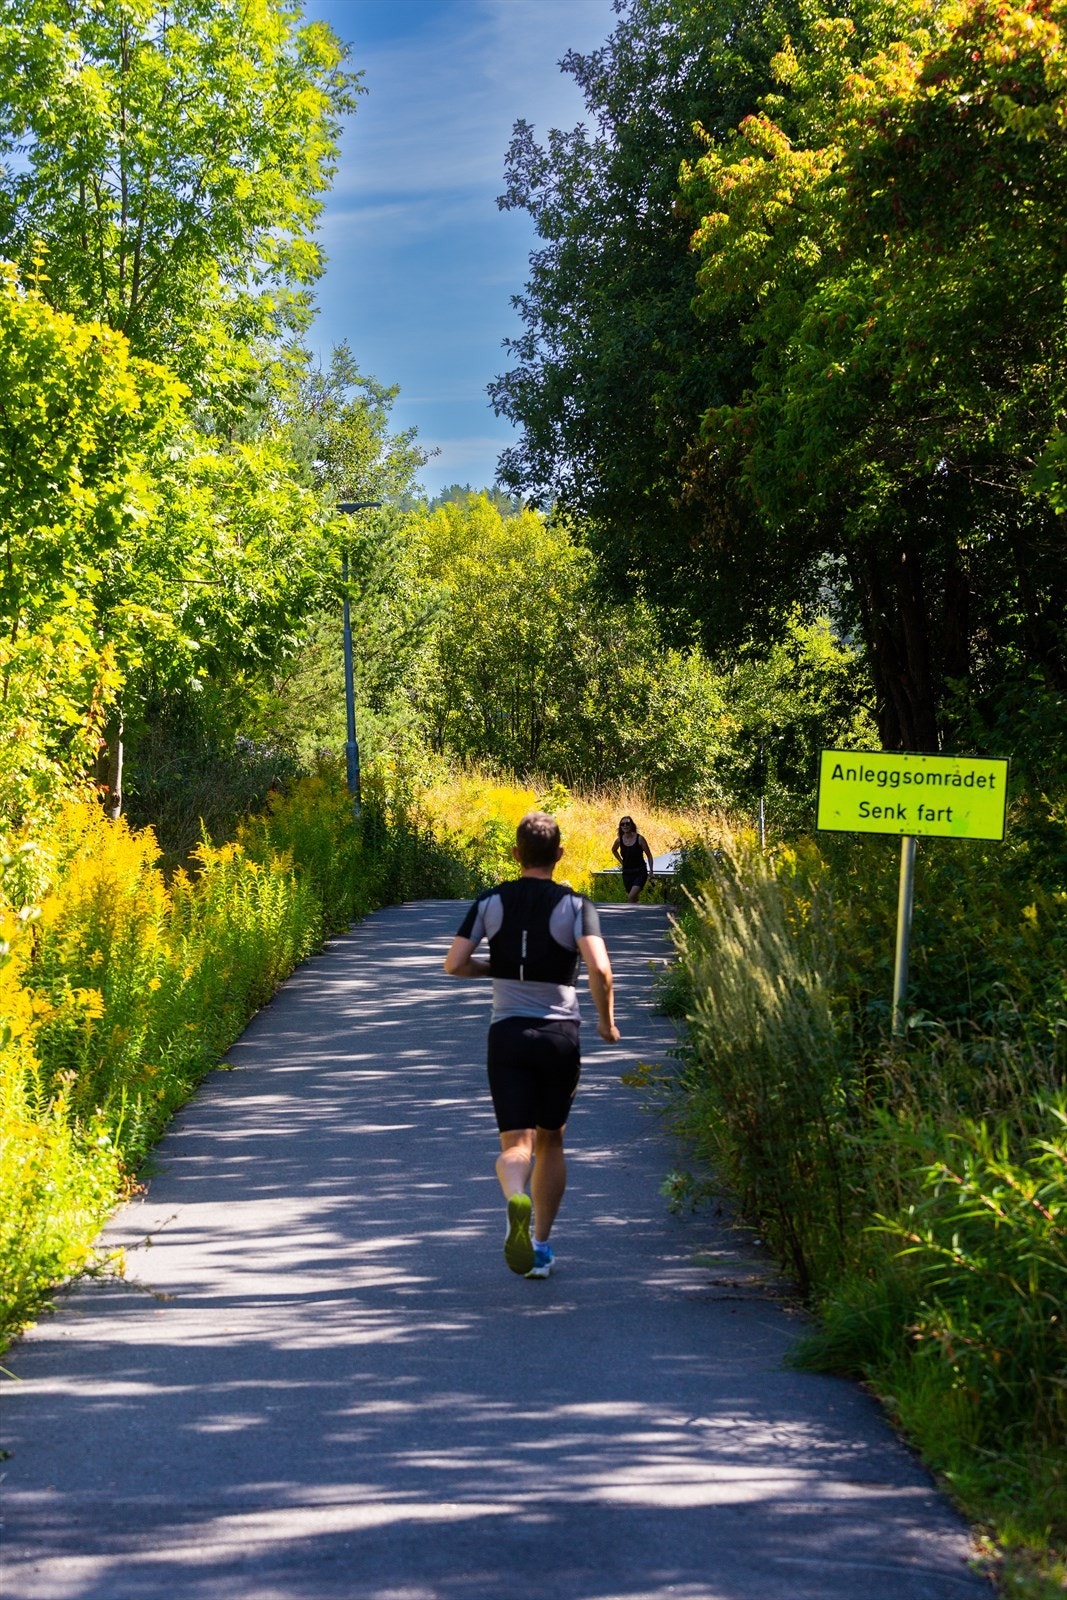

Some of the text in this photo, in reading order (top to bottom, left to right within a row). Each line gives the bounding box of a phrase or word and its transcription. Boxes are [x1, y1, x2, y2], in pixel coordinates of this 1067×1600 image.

[831, 763, 996, 789] Anleggsområdet
[858, 801, 953, 822] Senk fart
